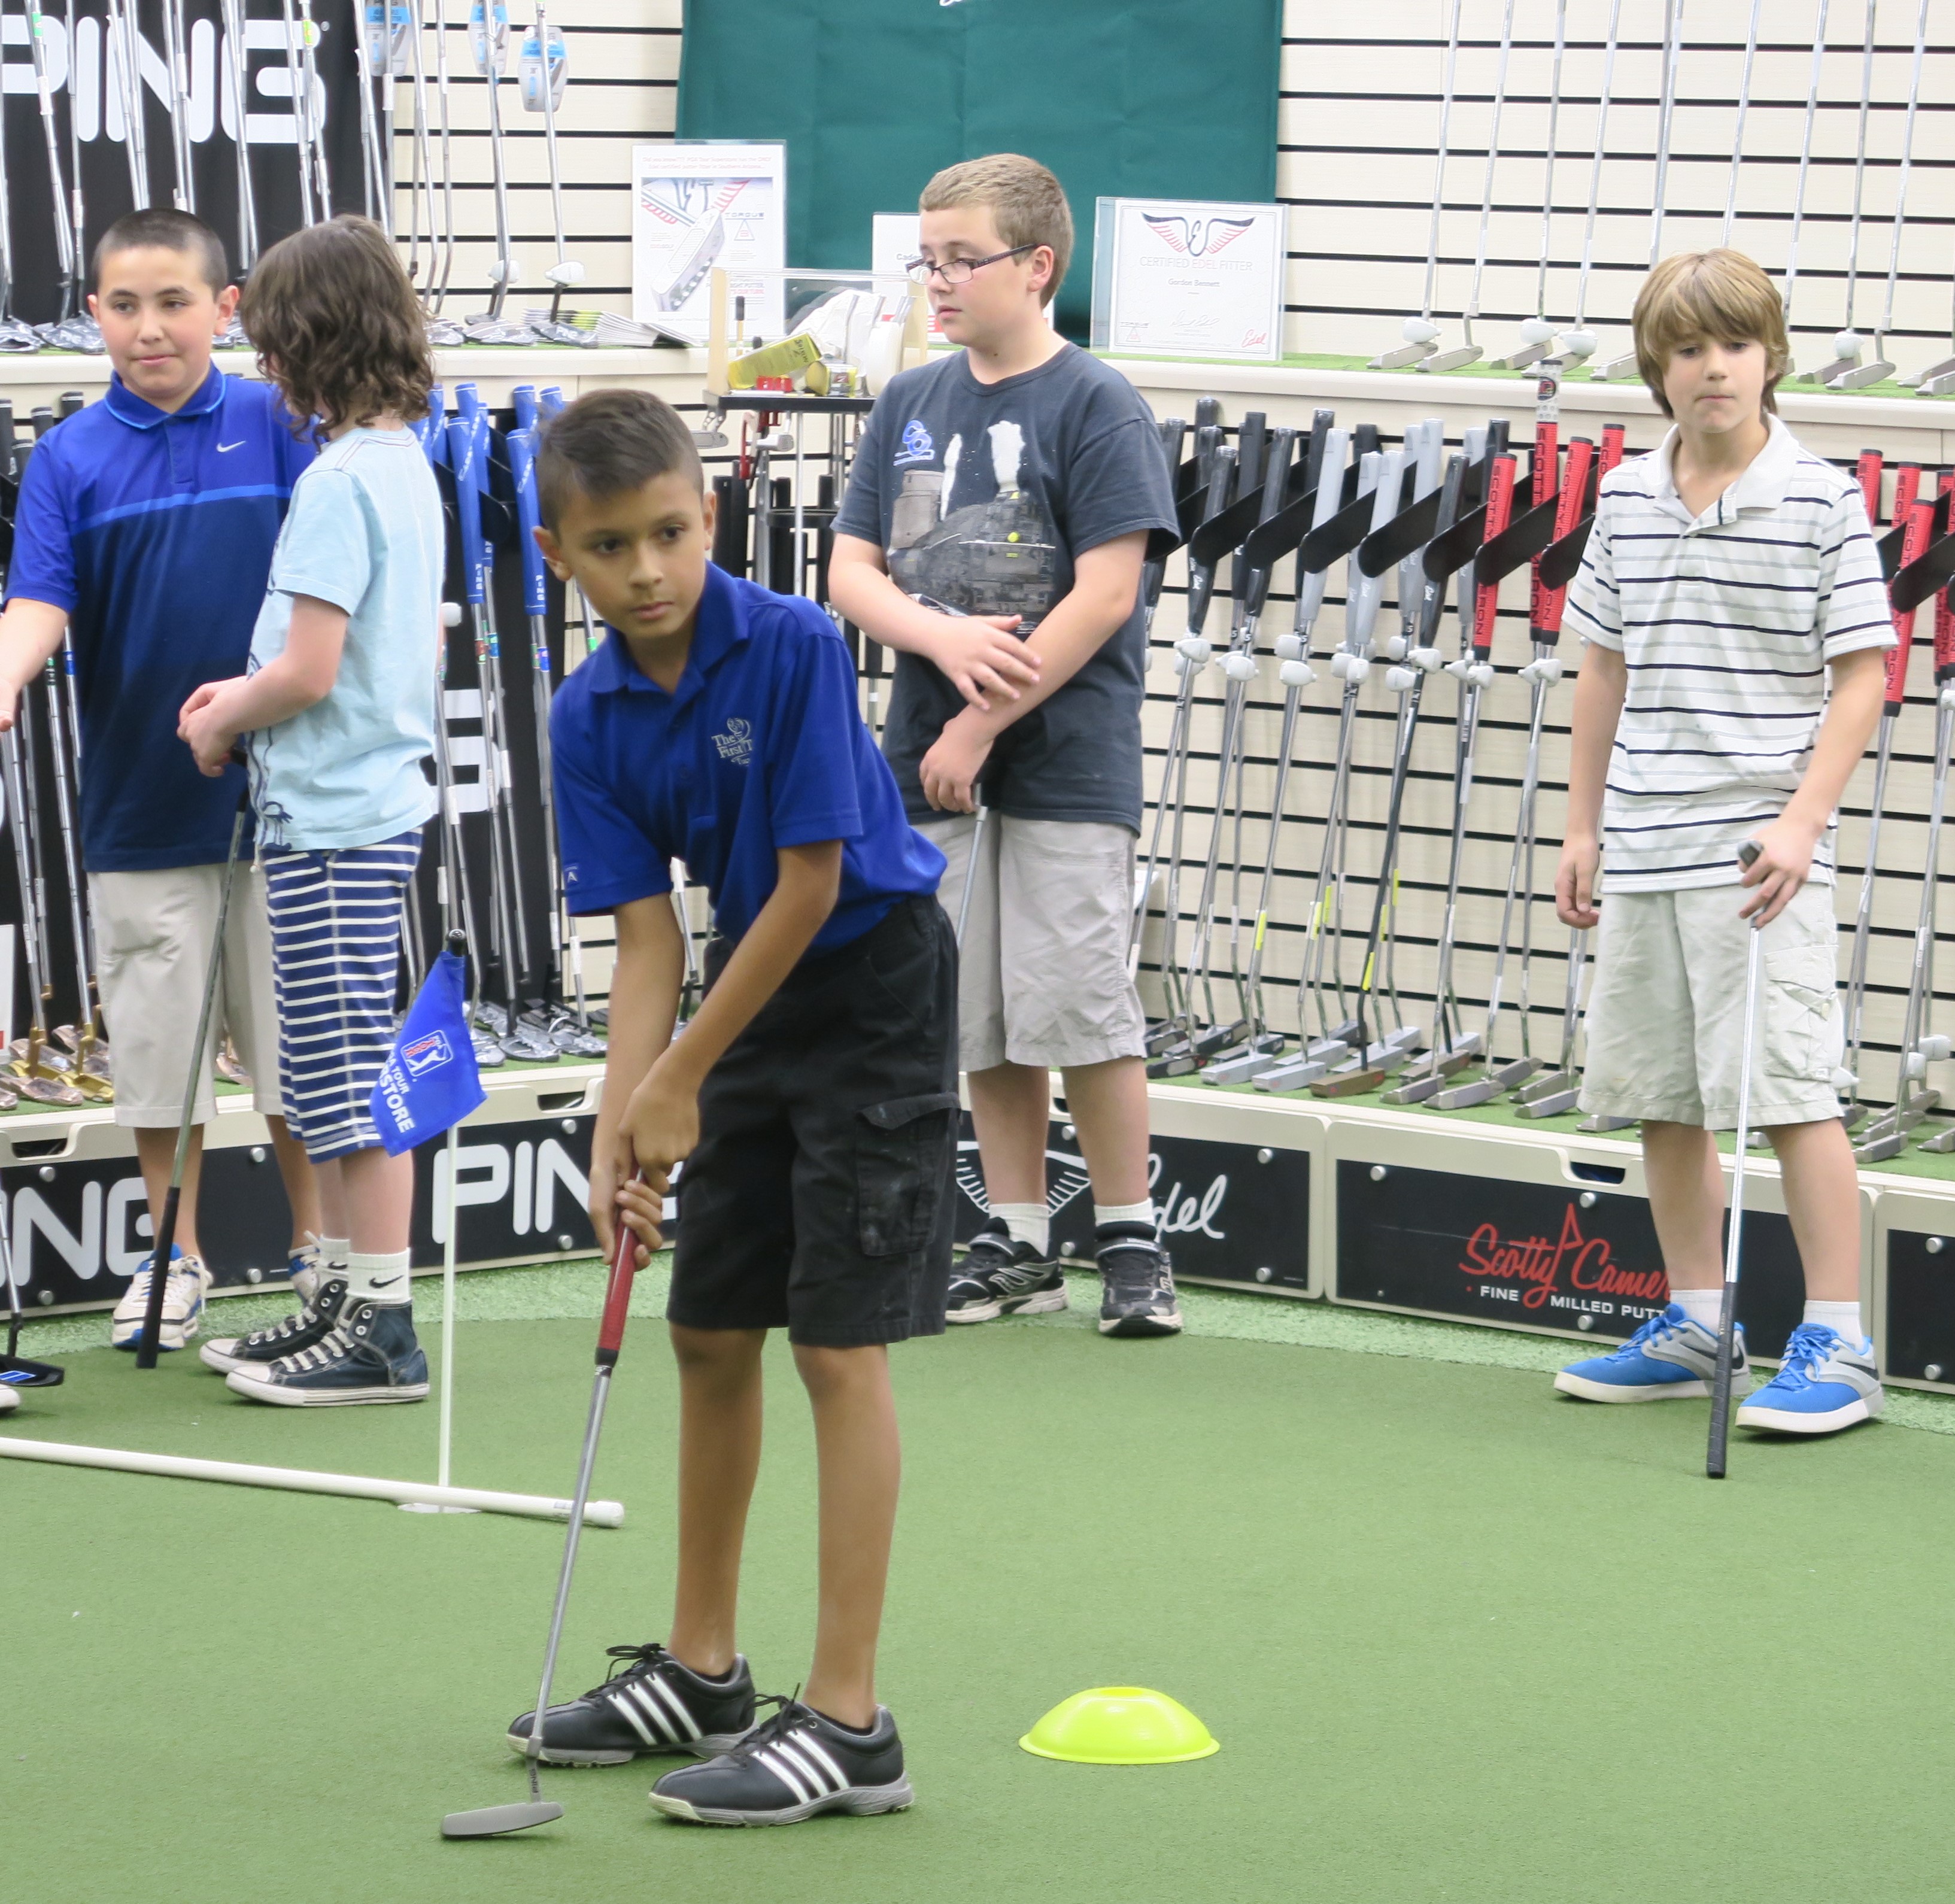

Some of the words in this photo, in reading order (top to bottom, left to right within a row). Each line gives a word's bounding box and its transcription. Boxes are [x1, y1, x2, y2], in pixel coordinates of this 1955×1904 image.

[1139, 256, 1191, 268] CERTIFIED
[1191, 259, 1218, 269] EDEL
[1219, 260, 1253, 271] FITTER
[1168, 278, 1192, 286] Gordon
[1902, 512, 1917, 564] SCOT
[711, 734, 736, 747] The
[717, 745, 744, 759] First
[391, 1065, 410, 1095] TOUR
[378, 1065, 415, 1134] RSTORE
[432, 1138, 591, 1244] PIN
[1458, 1223, 1559, 1309] Scotty
[1480, 1285, 1519, 1302] FINE
[1550, 1295, 1614, 1315] MILLED
[1621, 1305, 1665, 1320] PUTT
